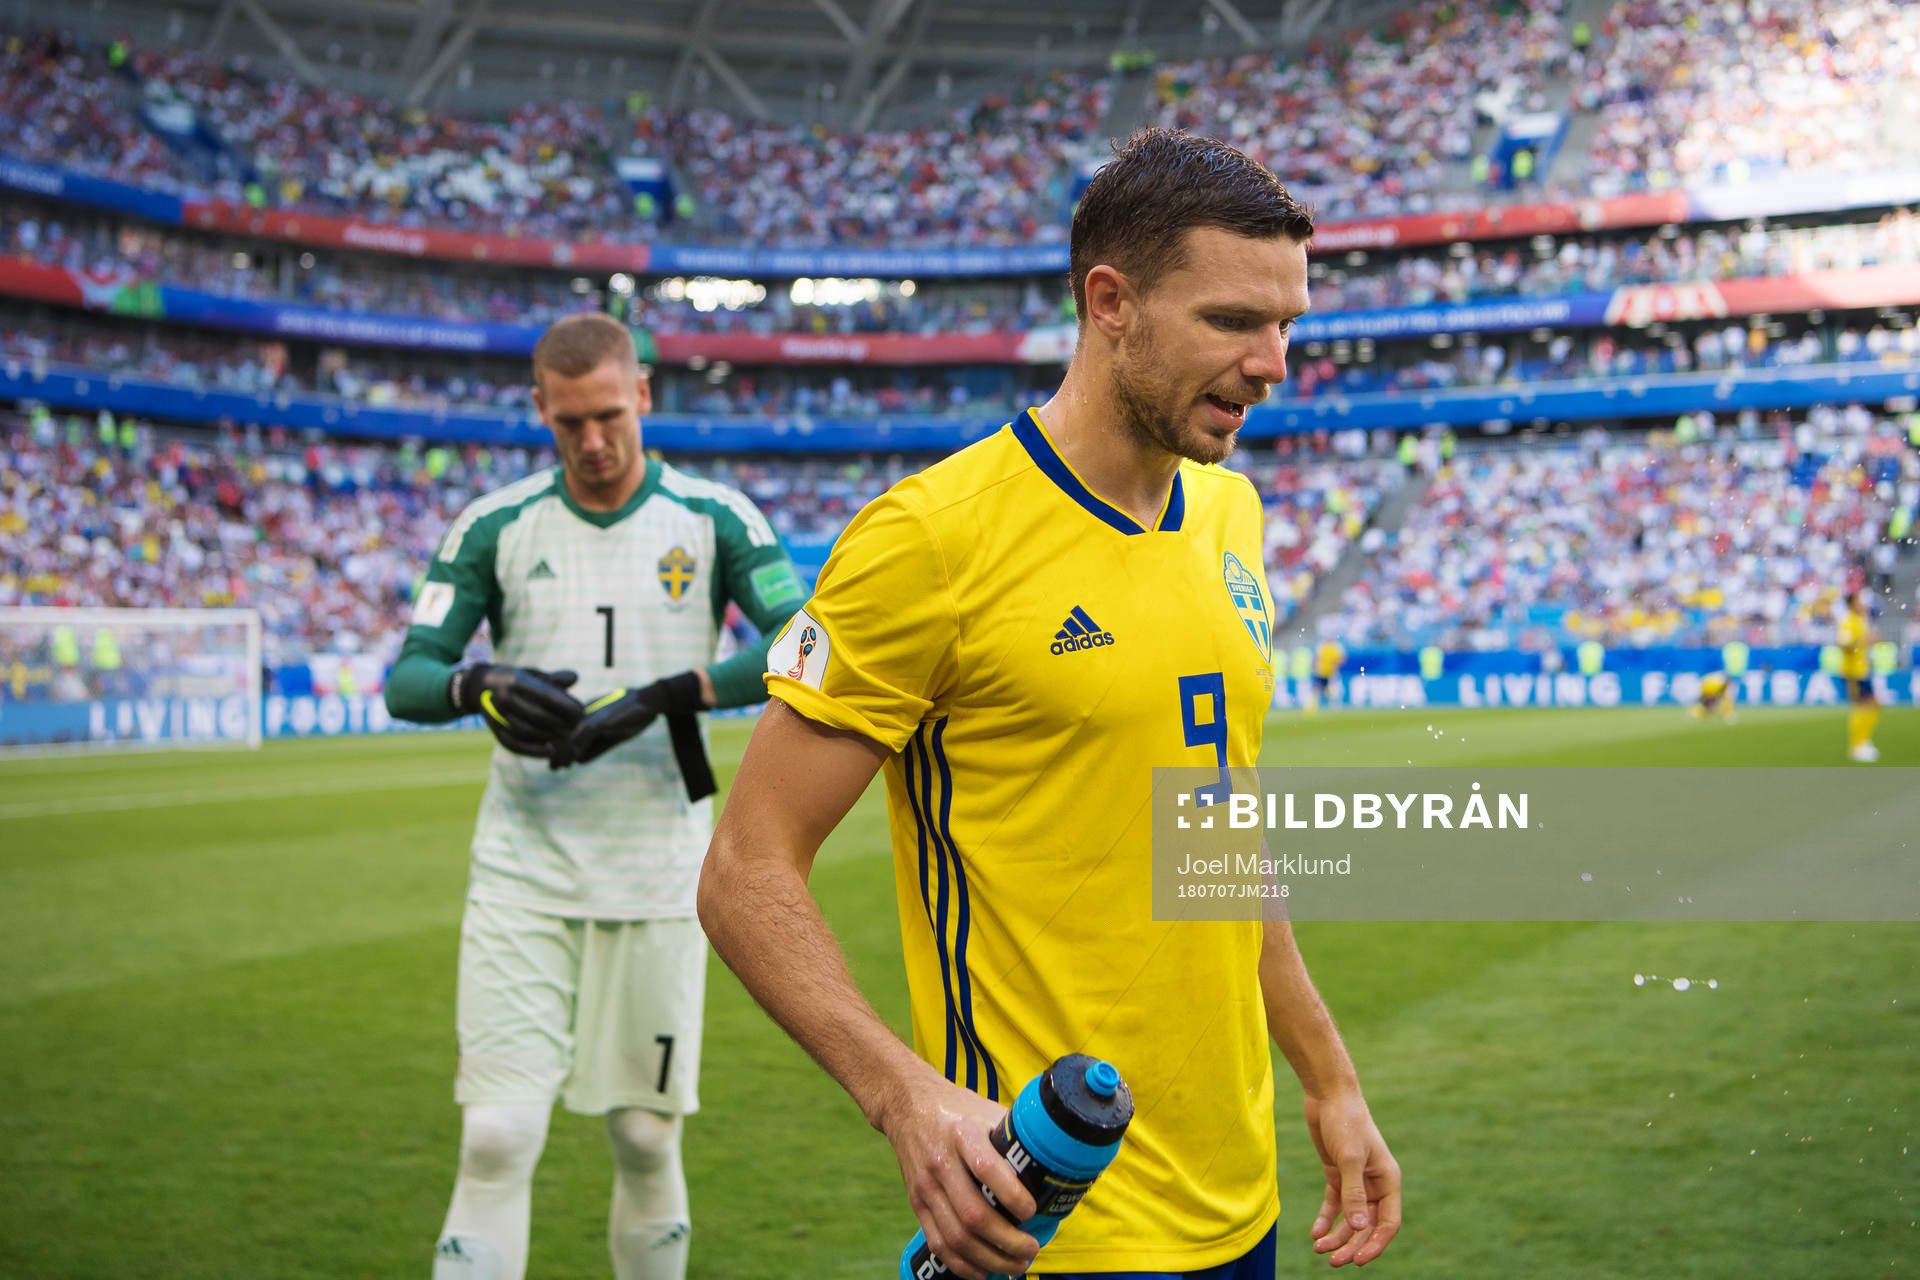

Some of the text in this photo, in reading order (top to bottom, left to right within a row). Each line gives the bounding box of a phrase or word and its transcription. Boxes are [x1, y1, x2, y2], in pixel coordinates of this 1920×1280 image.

[596, 607, 614, 668] 1
[1050, 631, 1115, 656] adidas
[1458, 672, 1622, 707] LIVING
[89, 698, 250, 743] LIVING
[1178, 672, 1233, 808] 9
[655, 1034, 674, 1094] 1
